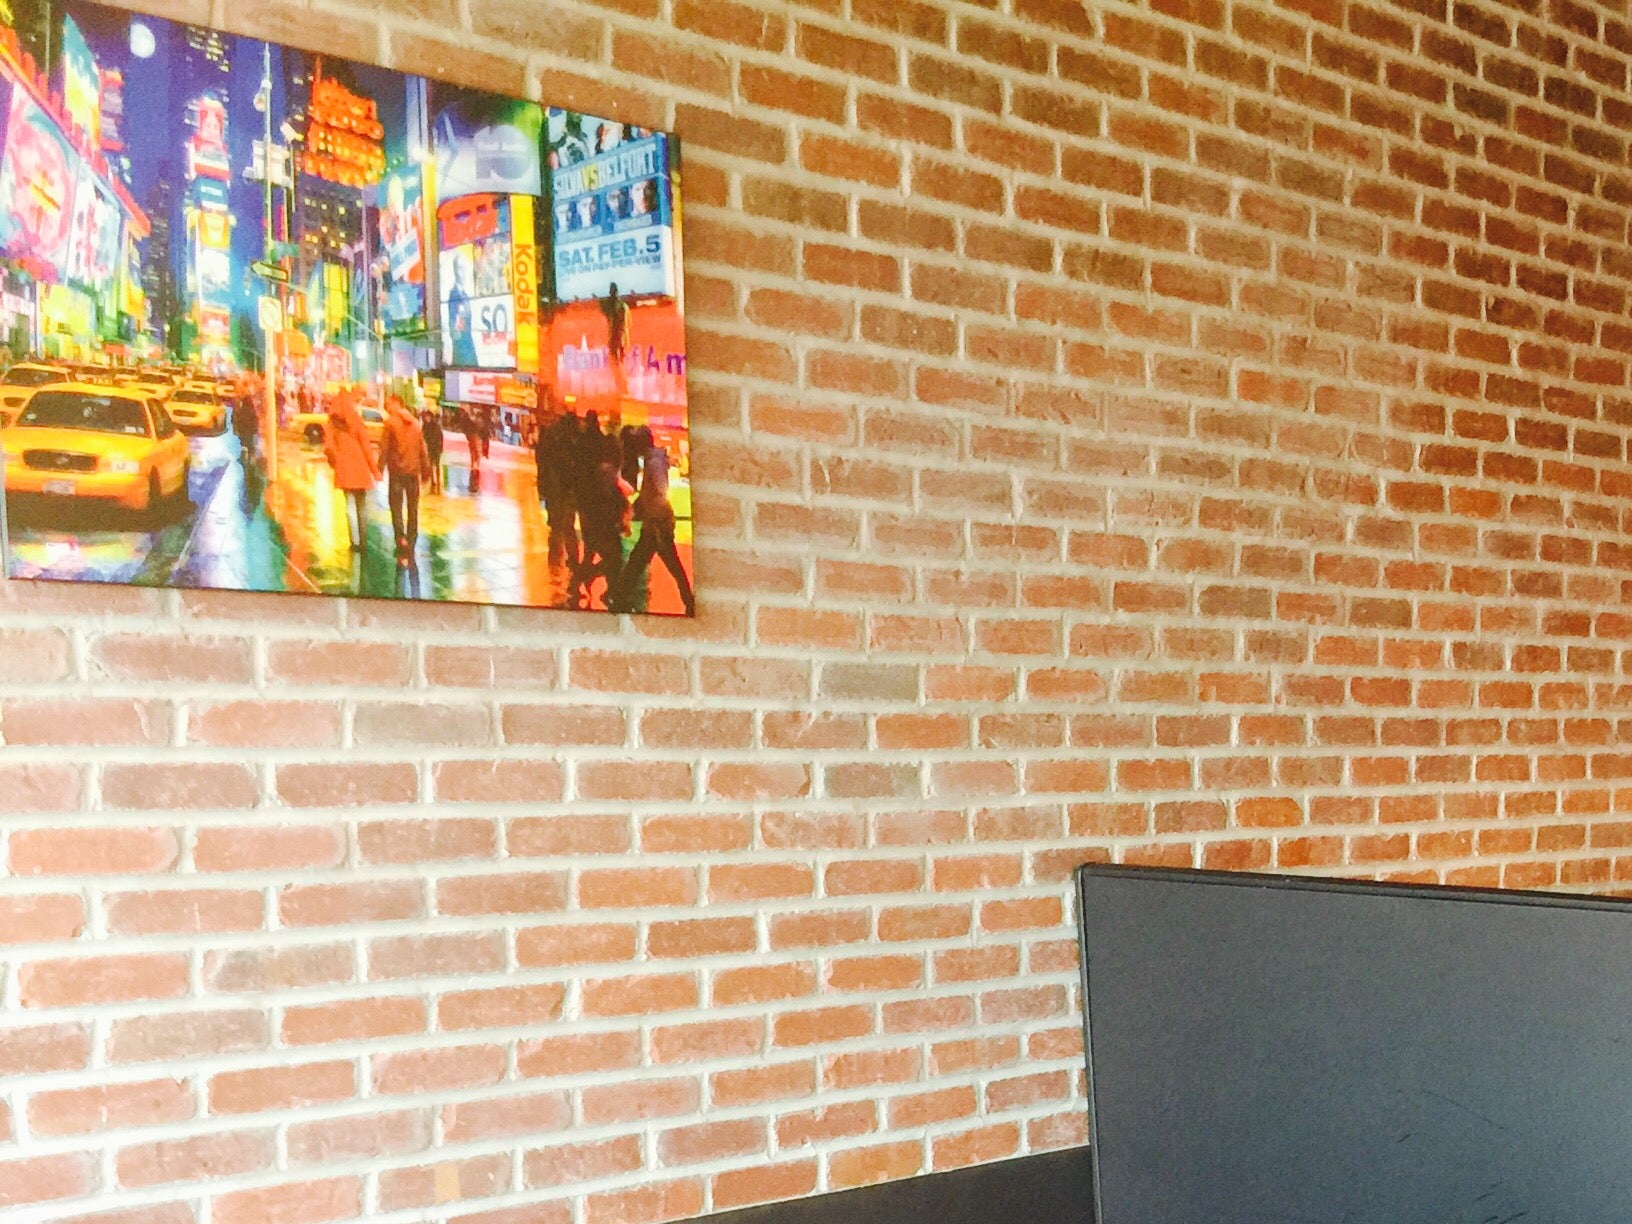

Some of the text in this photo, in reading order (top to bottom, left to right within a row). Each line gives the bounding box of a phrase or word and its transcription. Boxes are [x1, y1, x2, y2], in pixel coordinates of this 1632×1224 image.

[553, 168, 584, 199] SILVA
[581, 163, 599, 192] VS
[559, 234, 661, 268] SAT. FEB. 5
[514, 242, 536, 328] Kodak
